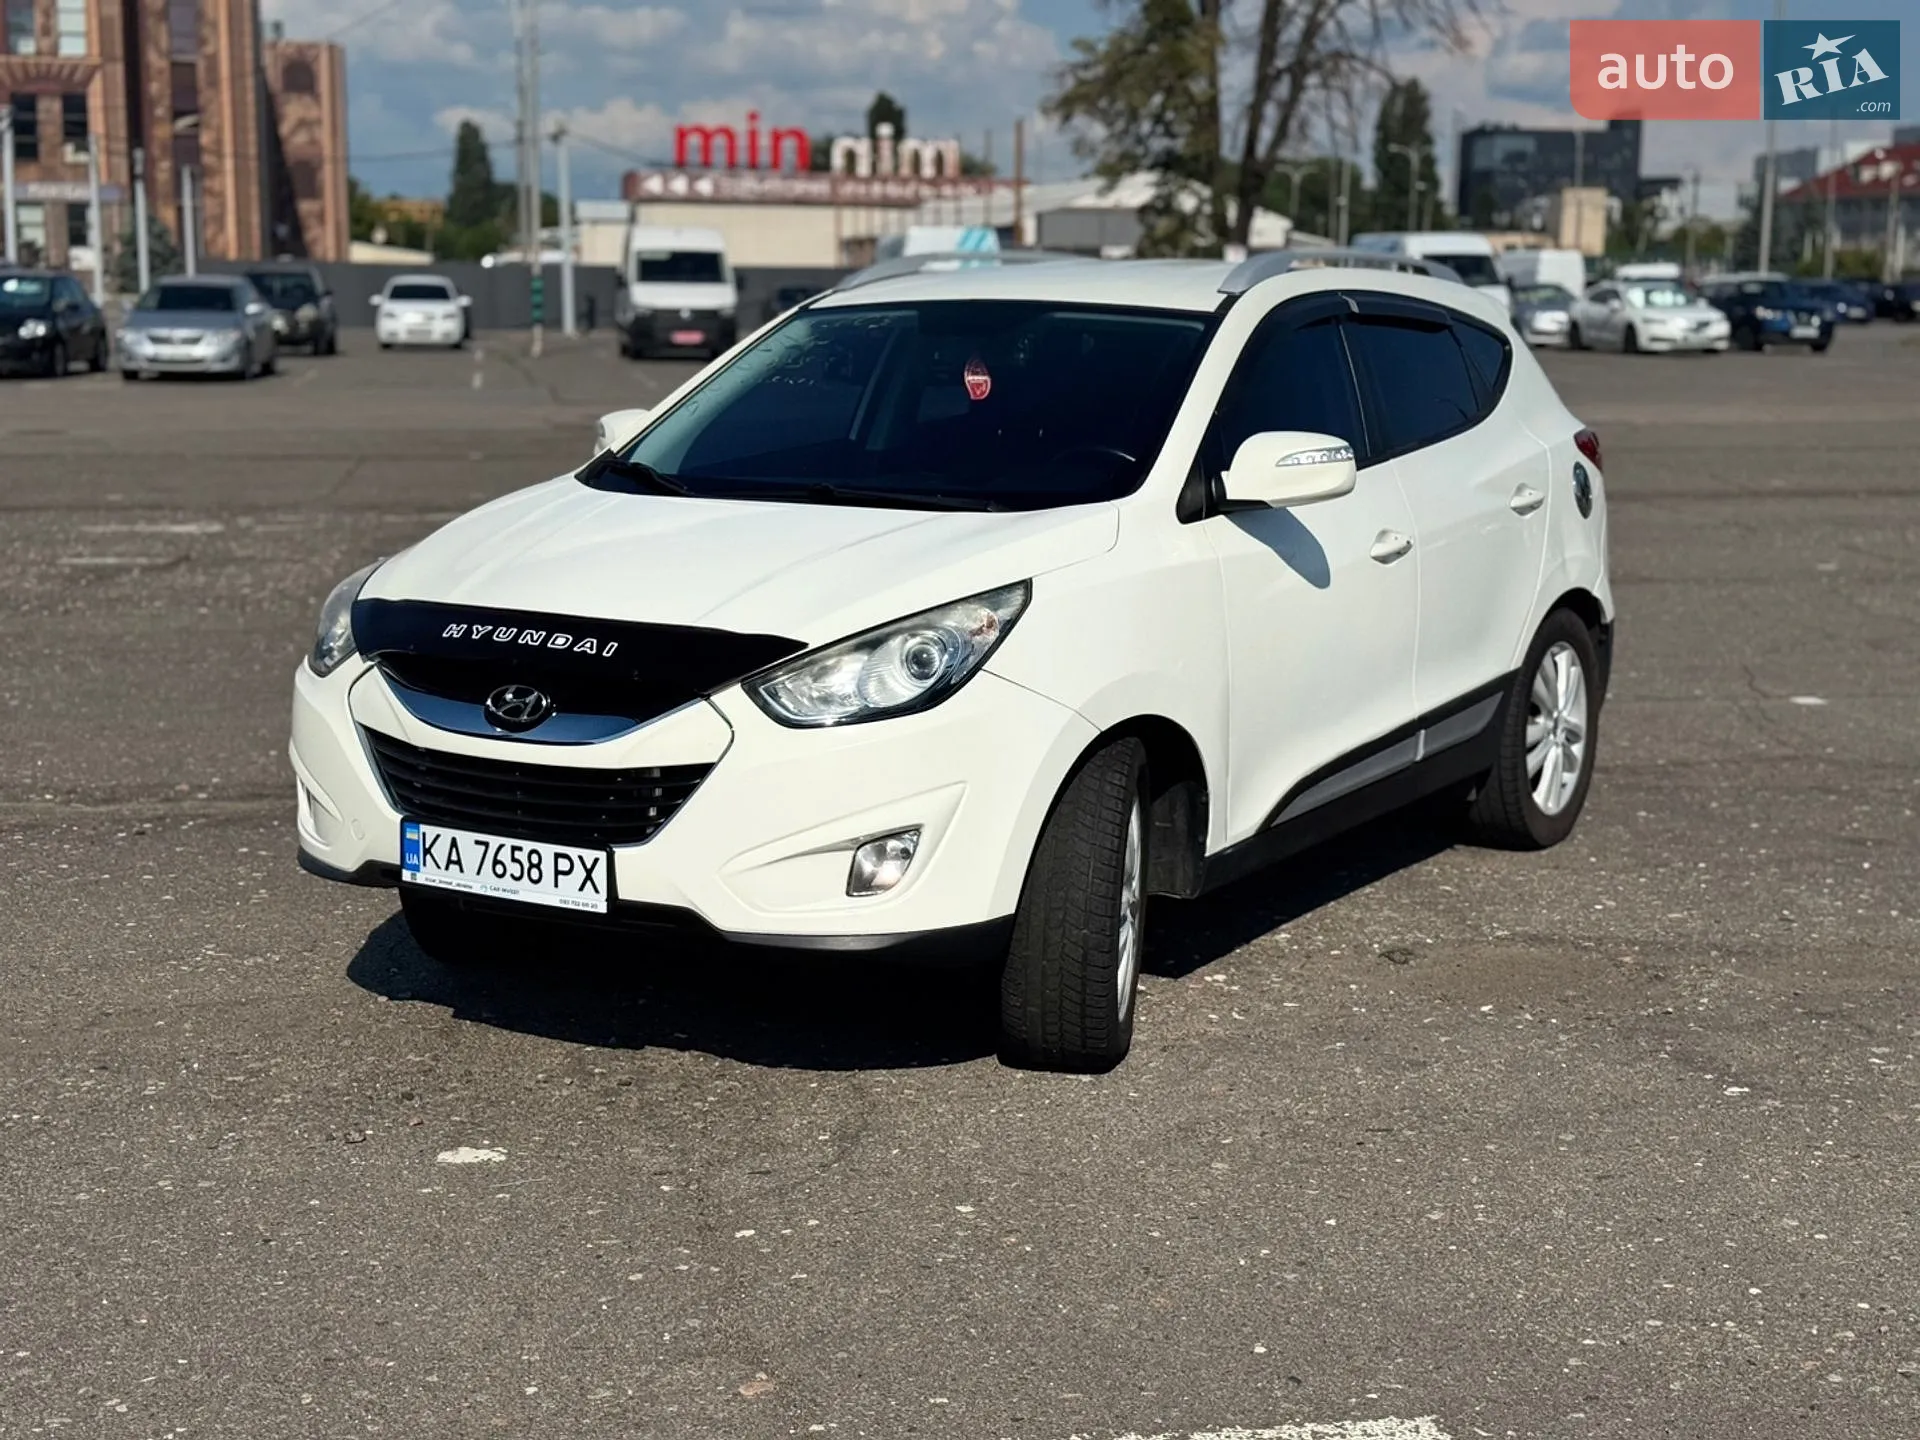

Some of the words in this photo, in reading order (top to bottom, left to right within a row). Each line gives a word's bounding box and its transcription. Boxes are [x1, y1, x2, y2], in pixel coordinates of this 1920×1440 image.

[675, 110, 811, 172] min
[442, 623, 619, 658] HYUNDAI
[406, 852, 419, 866] UA
[421, 831, 465, 874] KA
[474, 839, 543, 885] 7658
[553, 851, 601, 895] PX
